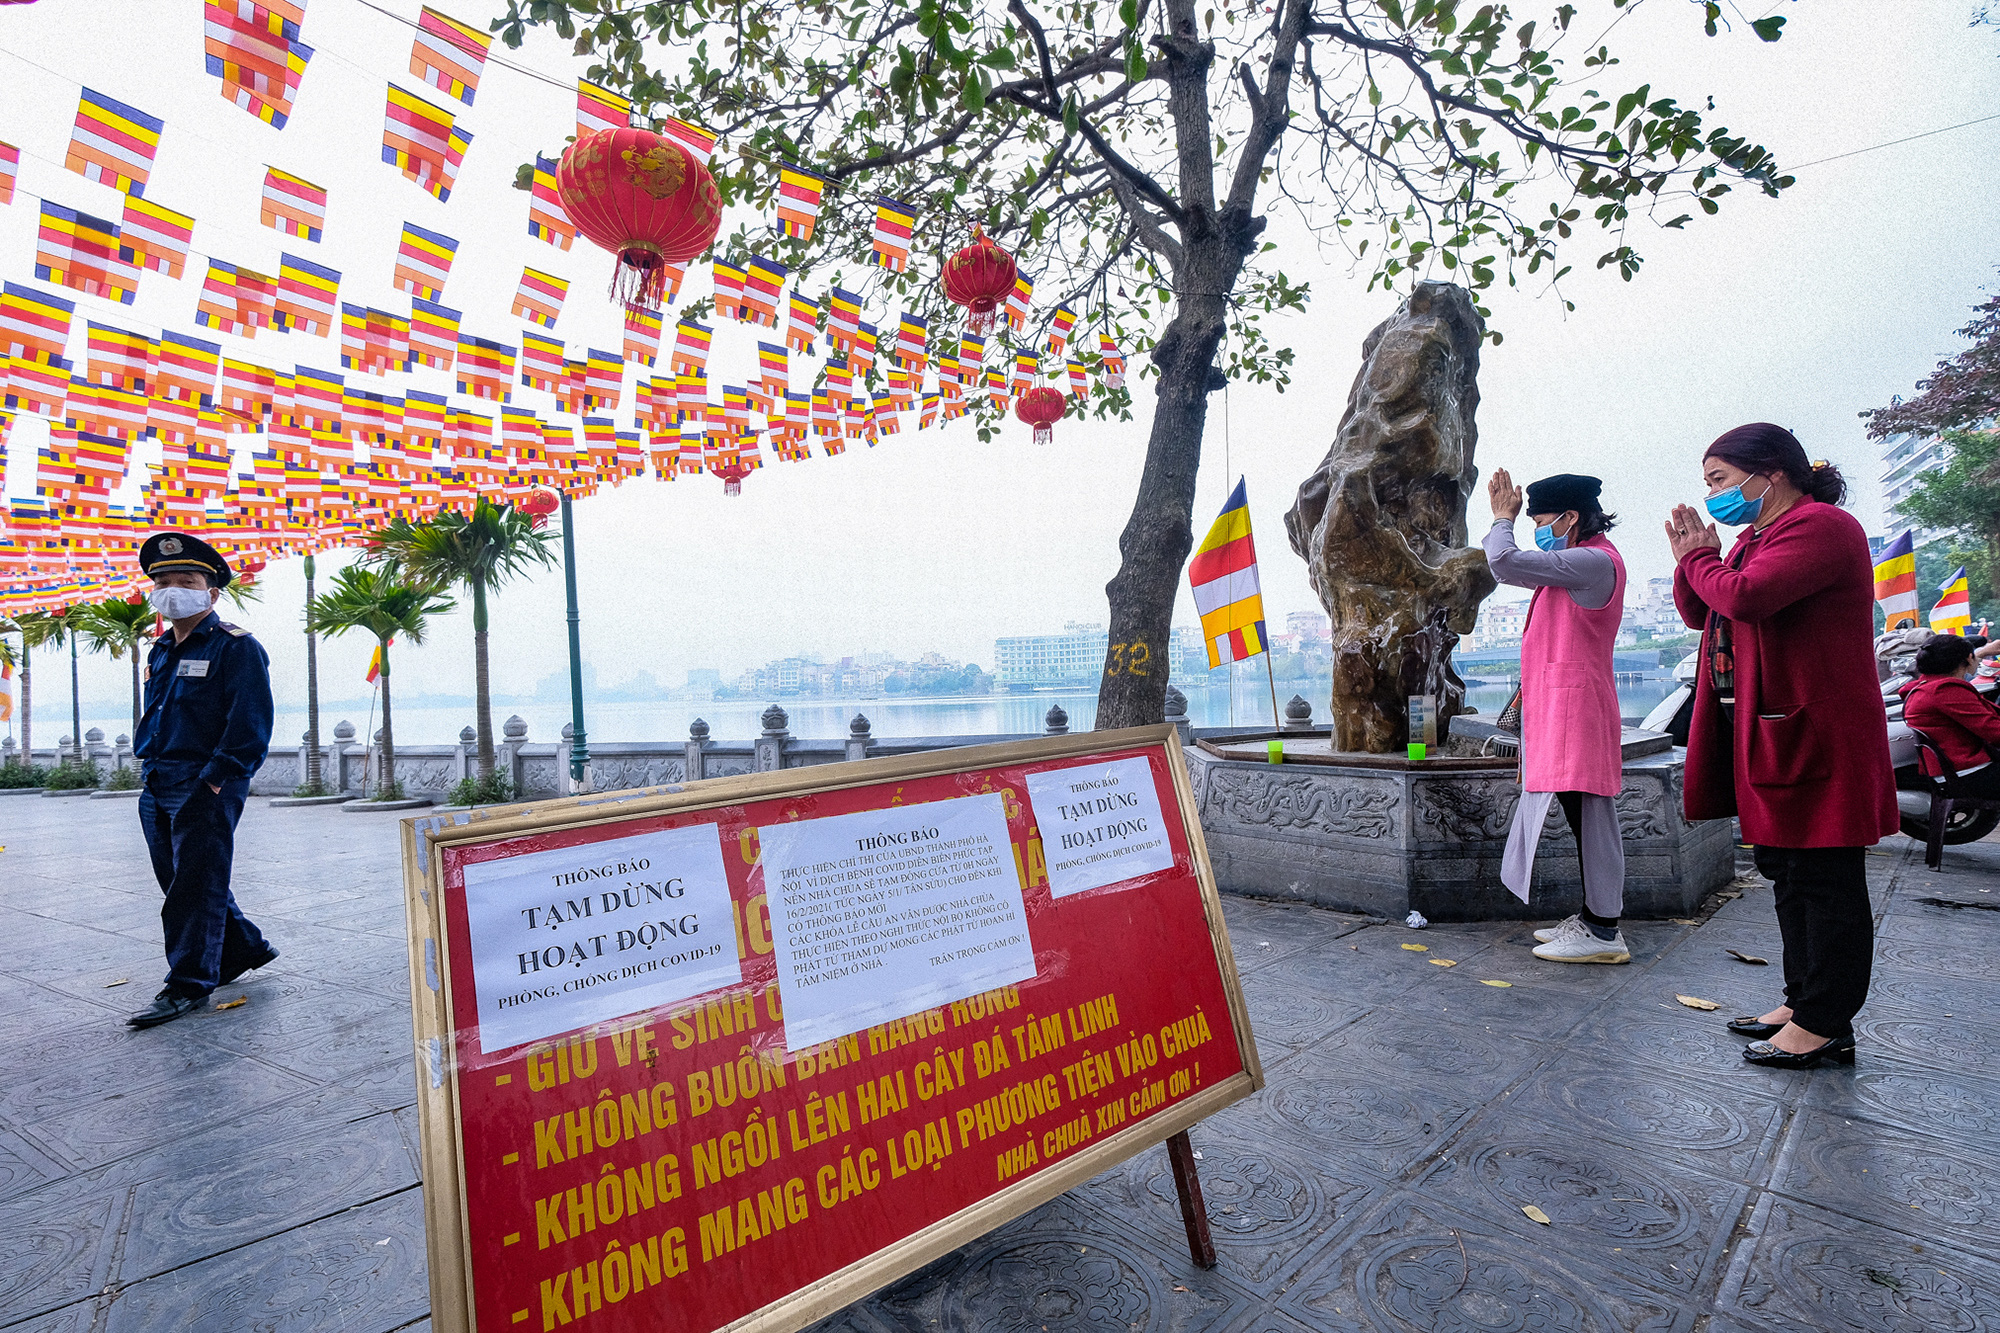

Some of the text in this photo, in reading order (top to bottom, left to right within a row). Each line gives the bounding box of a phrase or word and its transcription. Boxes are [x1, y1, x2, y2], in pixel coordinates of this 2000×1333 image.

[1108, 640, 1149, 677] 32
[1057, 792, 1138, 822] TẠM DỪNG
[1069, 775, 1119, 793] THÔNG BÁO
[780, 833, 989, 880] THỰC HIỆN CHỈ THỊ CỦA UBND THÀNH PHỐ HÀ
[856, 826, 939, 852] THÔNG BÁO
[1055, 839, 1162, 871] PHÒNG, CHỐNG DỊCH COVID-19
[1061, 818, 1148, 850] HOẠT ĐỘNG
[552, 857, 651, 887] THÔNG BÁO
[782, 845, 993, 893] NỘI VÌ DỊCH BỆNH COVID DIỄN BIẾN PHỨC TẠP
[784, 893, 806, 906] NÊN
[808, 890, 831, 903] NHÀ
[833, 883, 861, 896] CHÙA
[864, 879, 876, 890] SẼ
[878, 876, 899, 889] TẠM
[900, 869, 927, 883] ĐÓNG
[928, 864, 948, 878] CỬA
[950, 862, 962, 873] TỪ
[975, 855, 999, 868] NGÀY
[834, 895, 856, 910] TỨC
[857, 891, 885, 905] NGÀY
[904, 883, 924, 896] TÂN
[948, 874, 967, 886] CHO
[968, 870, 986, 882] ĐẾN
[987, 867, 1002, 877] KHI
[521, 877, 685, 931] TẠM DỪNG
[787, 902, 887, 934] CÓ THÔNG BÁO MỚI
[789, 891, 995, 947] CÁC KHÓA LỄ CẦU AN VẪN ĐƯỢC NHÀ CHÙA
[517, 934, 608, 975] HOẠT
[616, 913, 700, 951] ĐỘNG
[791, 899, 1009, 961] THỰC HIỆN THEO NGHI THỨC NỘI BỘ KHÔNG CÓ
[793, 960, 822, 975] PHẬT
[824, 953, 840, 967] TỬ
[841, 948, 871, 963] THAM
[873, 942, 889, 955] DỰ
[890, 935, 919, 951] MONG
[920, 930, 940, 943] CÁC
[941, 925, 965, 938] PHẬT
[966, 920, 979, 931] TỬ
[980, 915, 1005, 929] HOAN
[929, 952, 955, 967] TRÂN
[955, 943, 986, 960] TRỌNG
[987, 937, 1007, 951] CẢM
[1008, 934, 1021, 947] ƠN
[498, 943, 722, 1010] PHÒNG, CHỐNG DỊCH COVID-19
[795, 974, 820, 989] TÂM
[822, 967, 849, 982] NIỆM
[850, 962, 861, 974] Ở
[861, 957, 883, 971] NHÀ
[670, 988, 757, 1050] SINH
[534, 1081, 678, 1170] KHÔNG
[687, 1045, 786, 1118] BUÔN
[535, 1154, 682, 1251] KHÔNG
[691, 1106, 781, 1190] NGỒI
[787, 1090, 851, 1152] LÊN
[856, 1070, 909, 1125] HAI
[914, 1047, 970, 1101] CÂY
[974, 1025, 1011, 1080] ĐÁ
[1012, 1013, 1066, 1063] TÂM
[1067, 993, 1120, 1040] LINH
[997, 1131, 1039, 1182] NHÀ
[1096, 1101, 1125, 1135] XIN
[1130, 1077, 1166, 1117] CẢM
[1169, 1068, 1190, 1098] ƠN
[539, 1226, 689, 1333] KHÔNG
[699, 1177, 809, 1264] MANG
[816, 1145, 881, 1209] CÁC
[887, 1116, 953, 1180] LOẠI
[956, 1073, 1061, 1149] PHƯƠNG
[1062, 1050, 1115, 1101] TIỆN
[1116, 1031, 1158, 1078] VÀO
